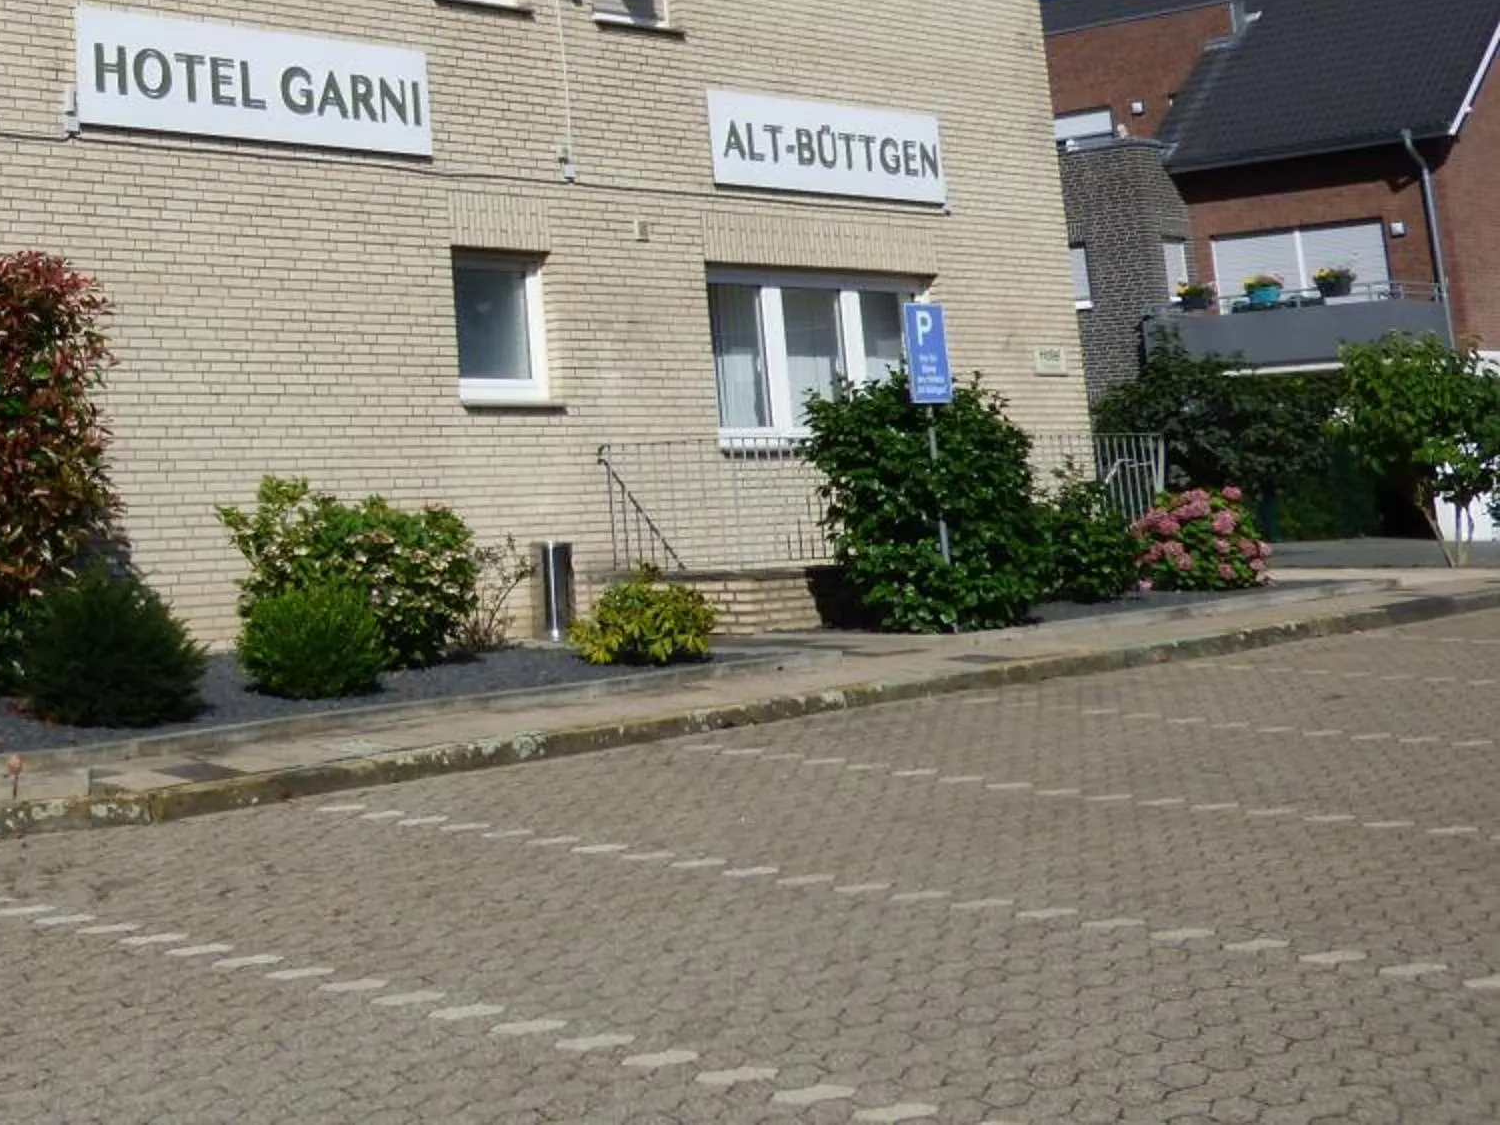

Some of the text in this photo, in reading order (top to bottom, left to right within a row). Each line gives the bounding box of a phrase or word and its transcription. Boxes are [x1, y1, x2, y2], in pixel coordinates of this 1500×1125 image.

[93, 42, 422, 126] HOTEL GARNI
[723, 120, 939, 179] ALT-BÜTTGEN
[915, 310, 932, 346] P
